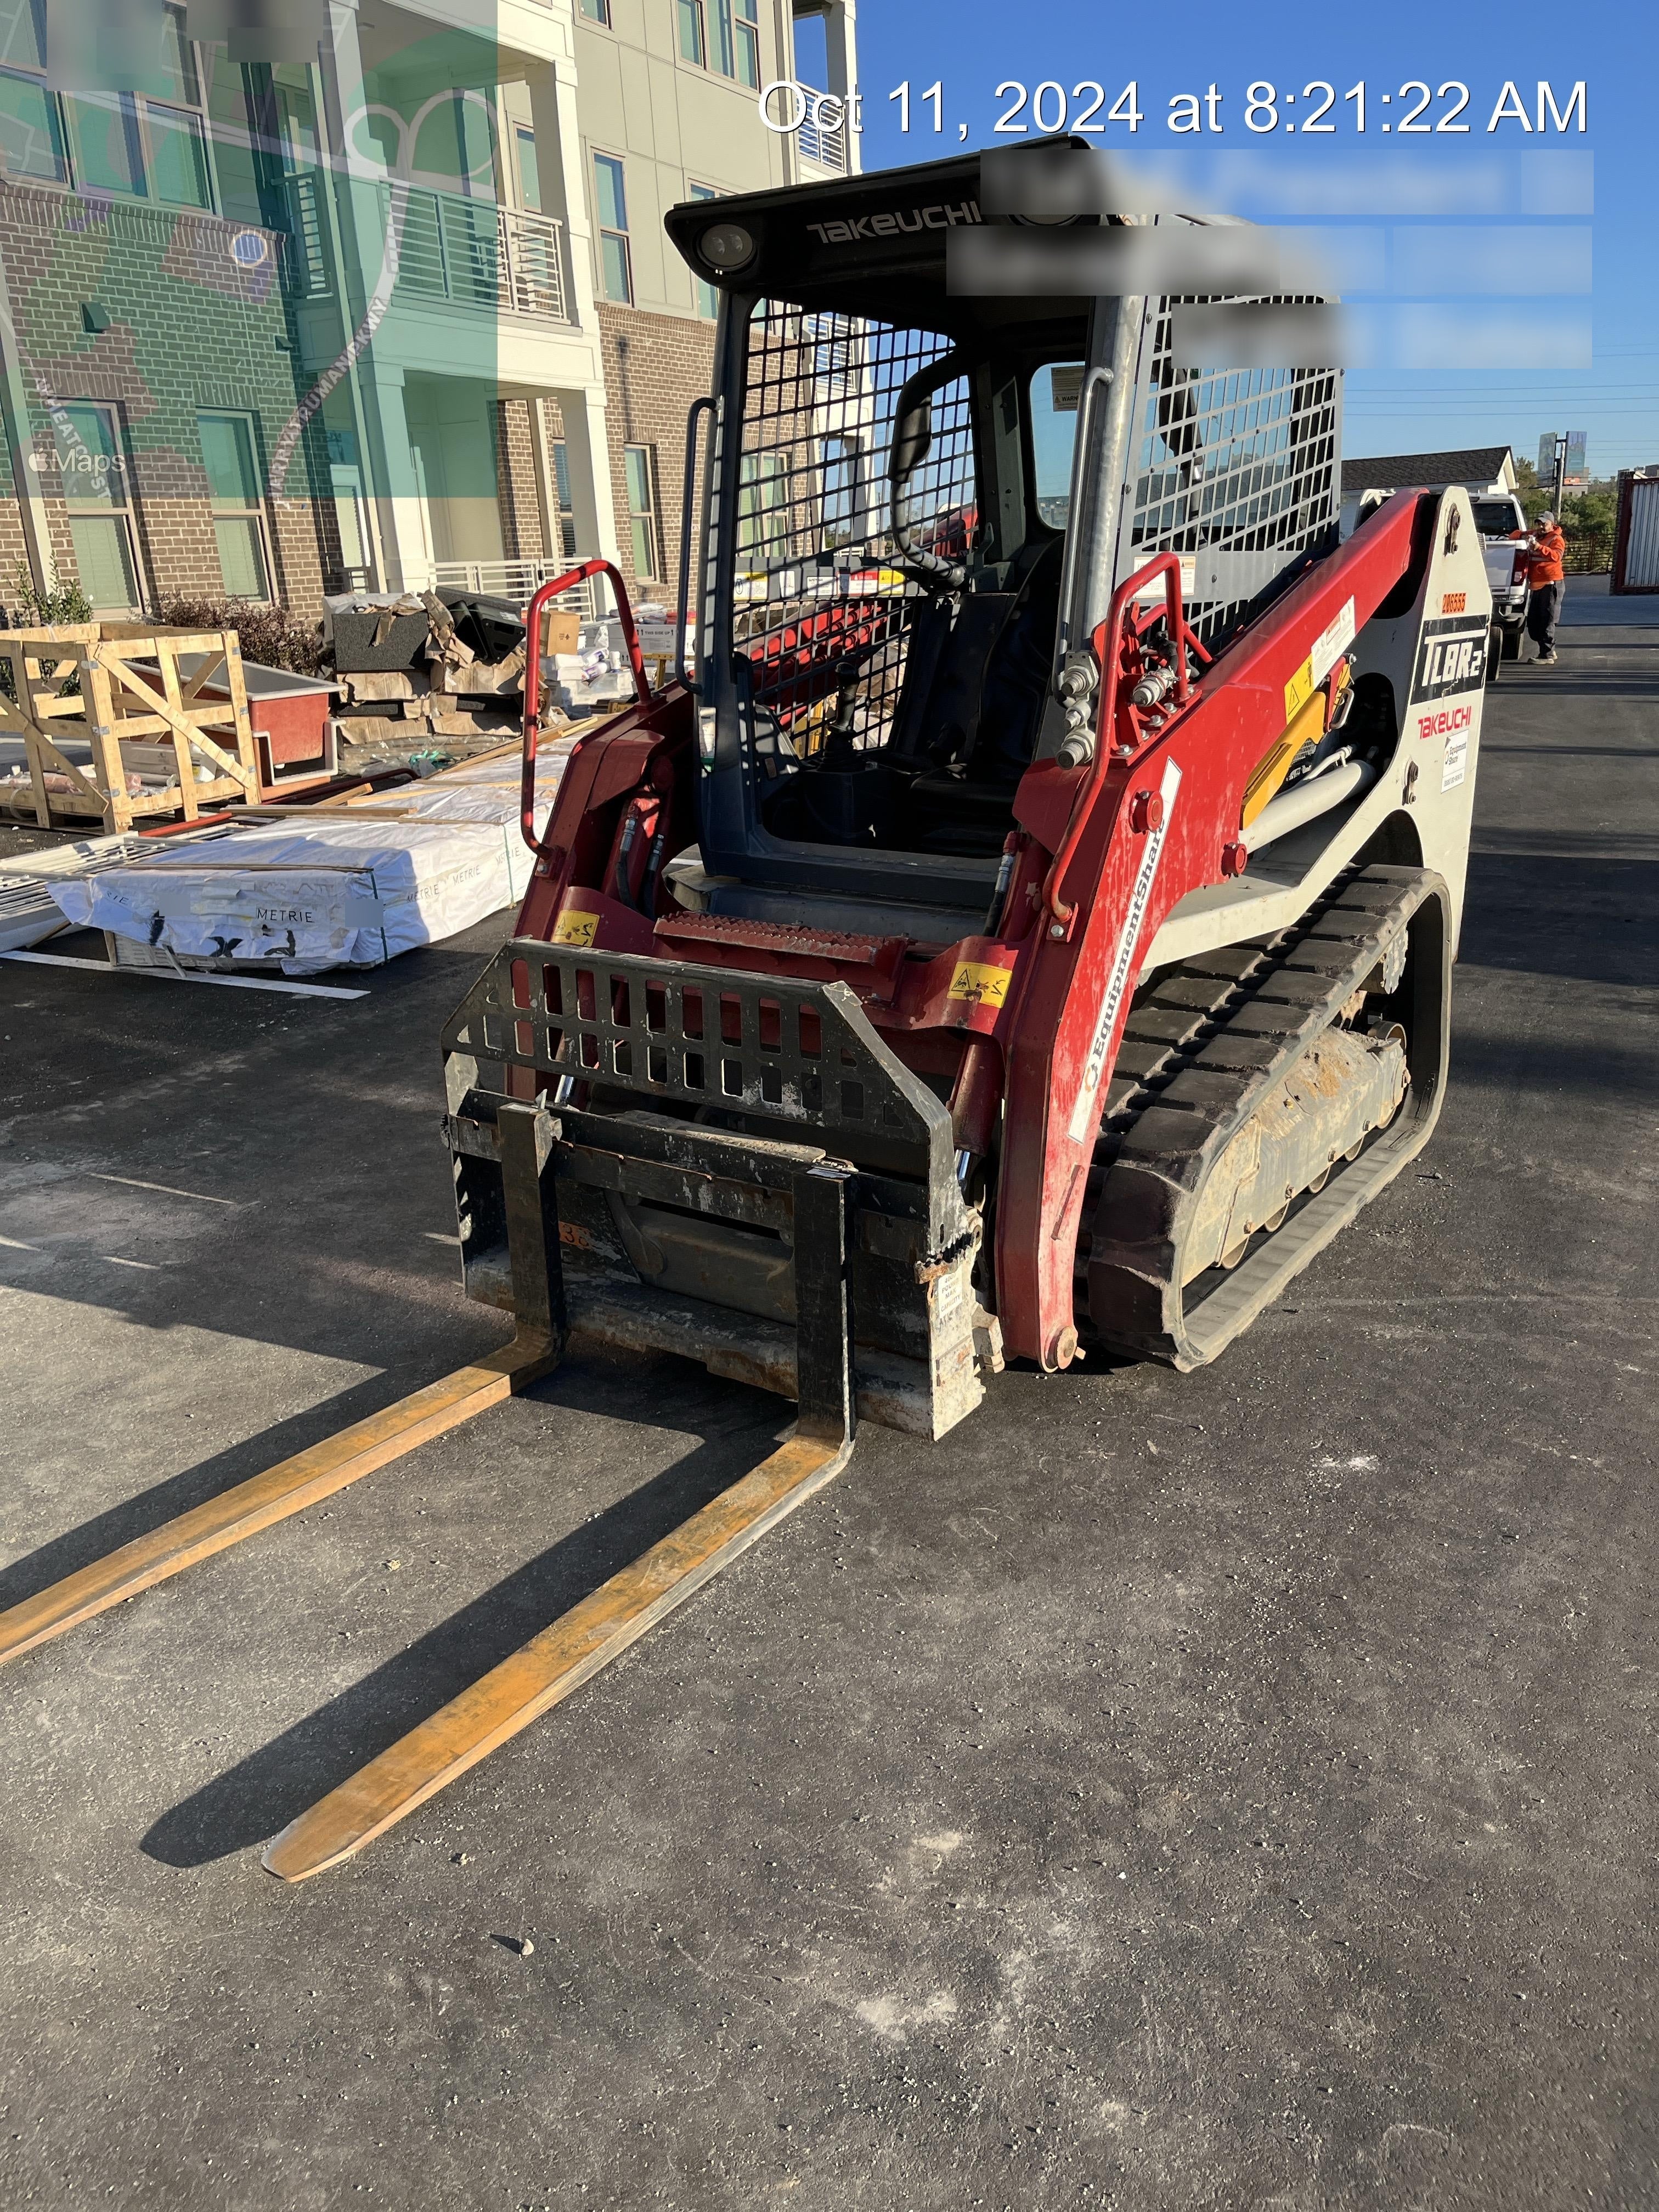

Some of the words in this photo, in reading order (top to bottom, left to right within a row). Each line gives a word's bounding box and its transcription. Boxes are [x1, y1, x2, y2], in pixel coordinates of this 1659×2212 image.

[453, 865, 481, 885] METRIE
[495, 847, 521, 866] METIE
[257, 909, 314, 923] METRIE
